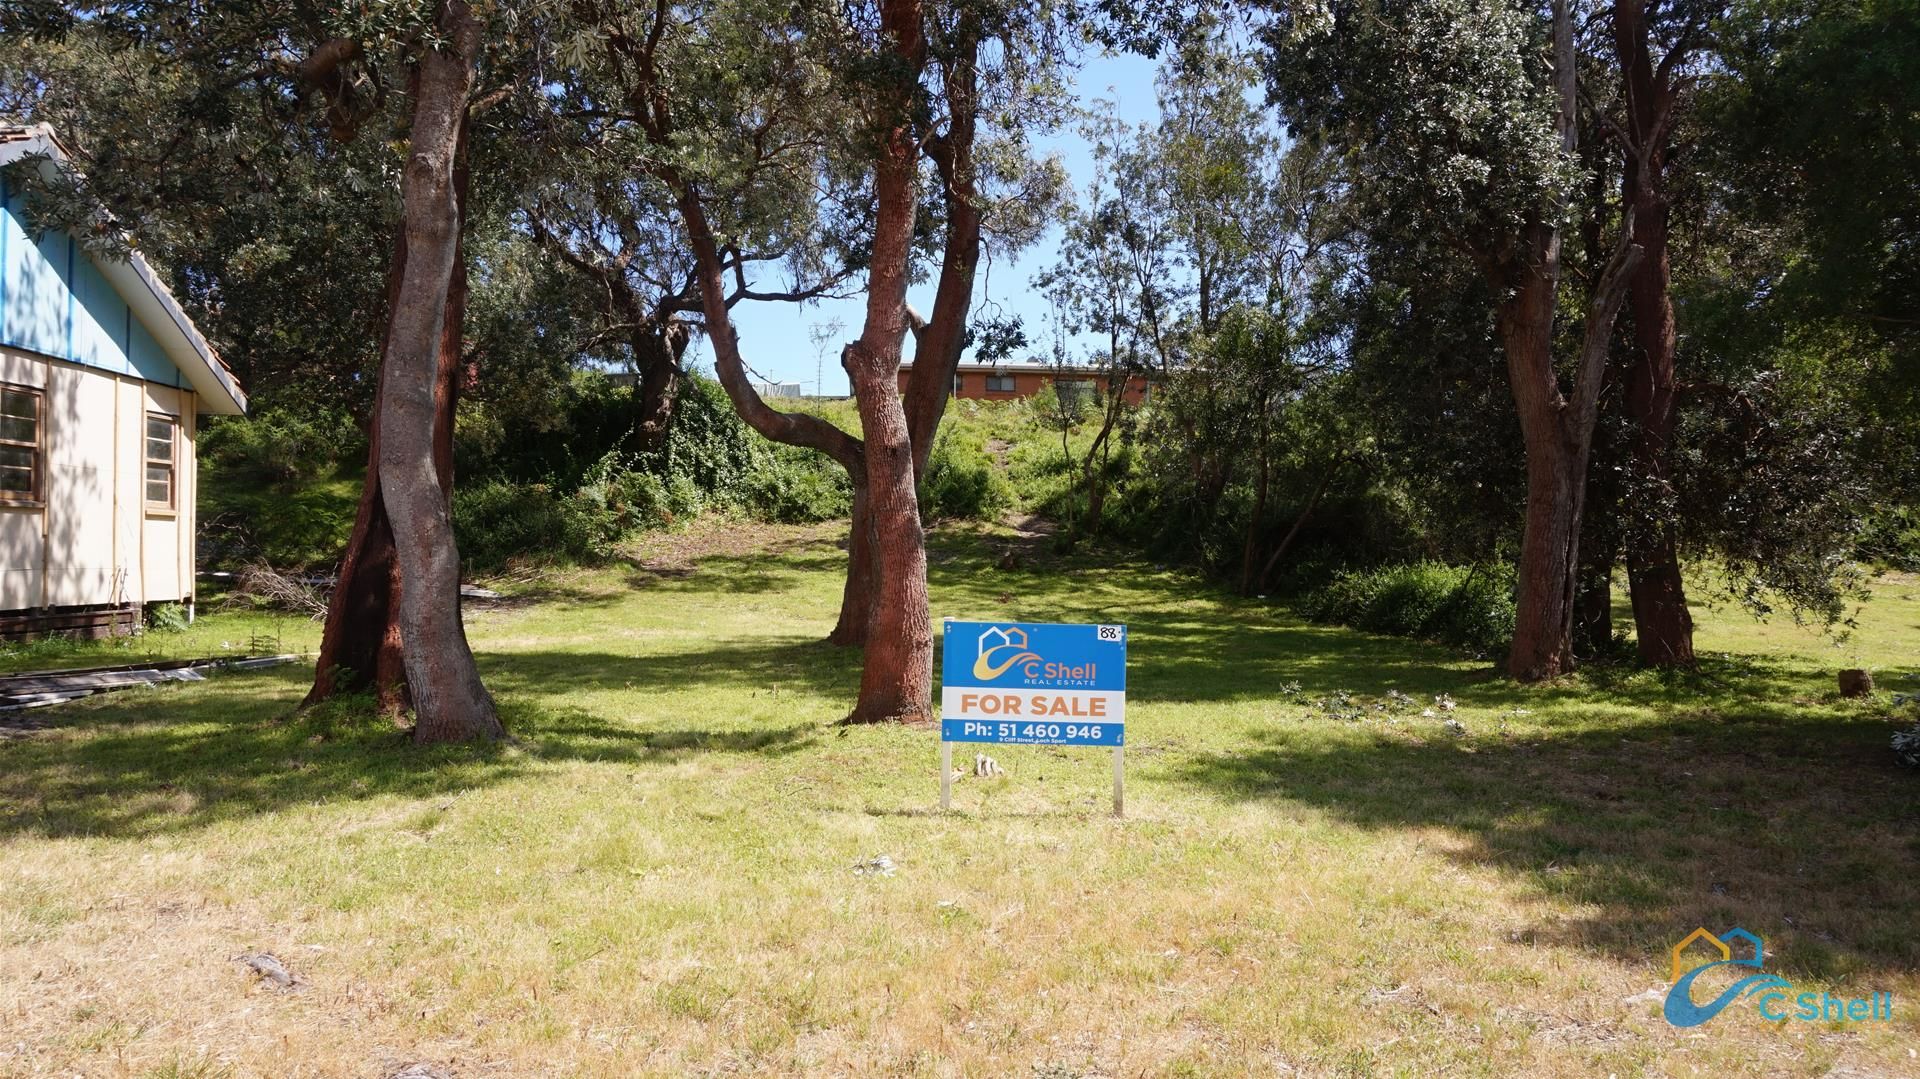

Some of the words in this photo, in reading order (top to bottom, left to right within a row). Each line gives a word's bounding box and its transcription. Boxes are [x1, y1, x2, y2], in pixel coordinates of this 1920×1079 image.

[1100, 627, 1117, 639] 88
[1024, 663, 1040, 679] C
[1044, 662, 1096, 679] Shell
[961, 694, 1022, 715] FOR
[1030, 695, 1107, 717] SALE
[964, 722, 992, 737] Ph:
[998, 723, 1016, 737] 51
[1022, 724, 1060, 738] 460
[1066, 725, 1102, 739] 946
